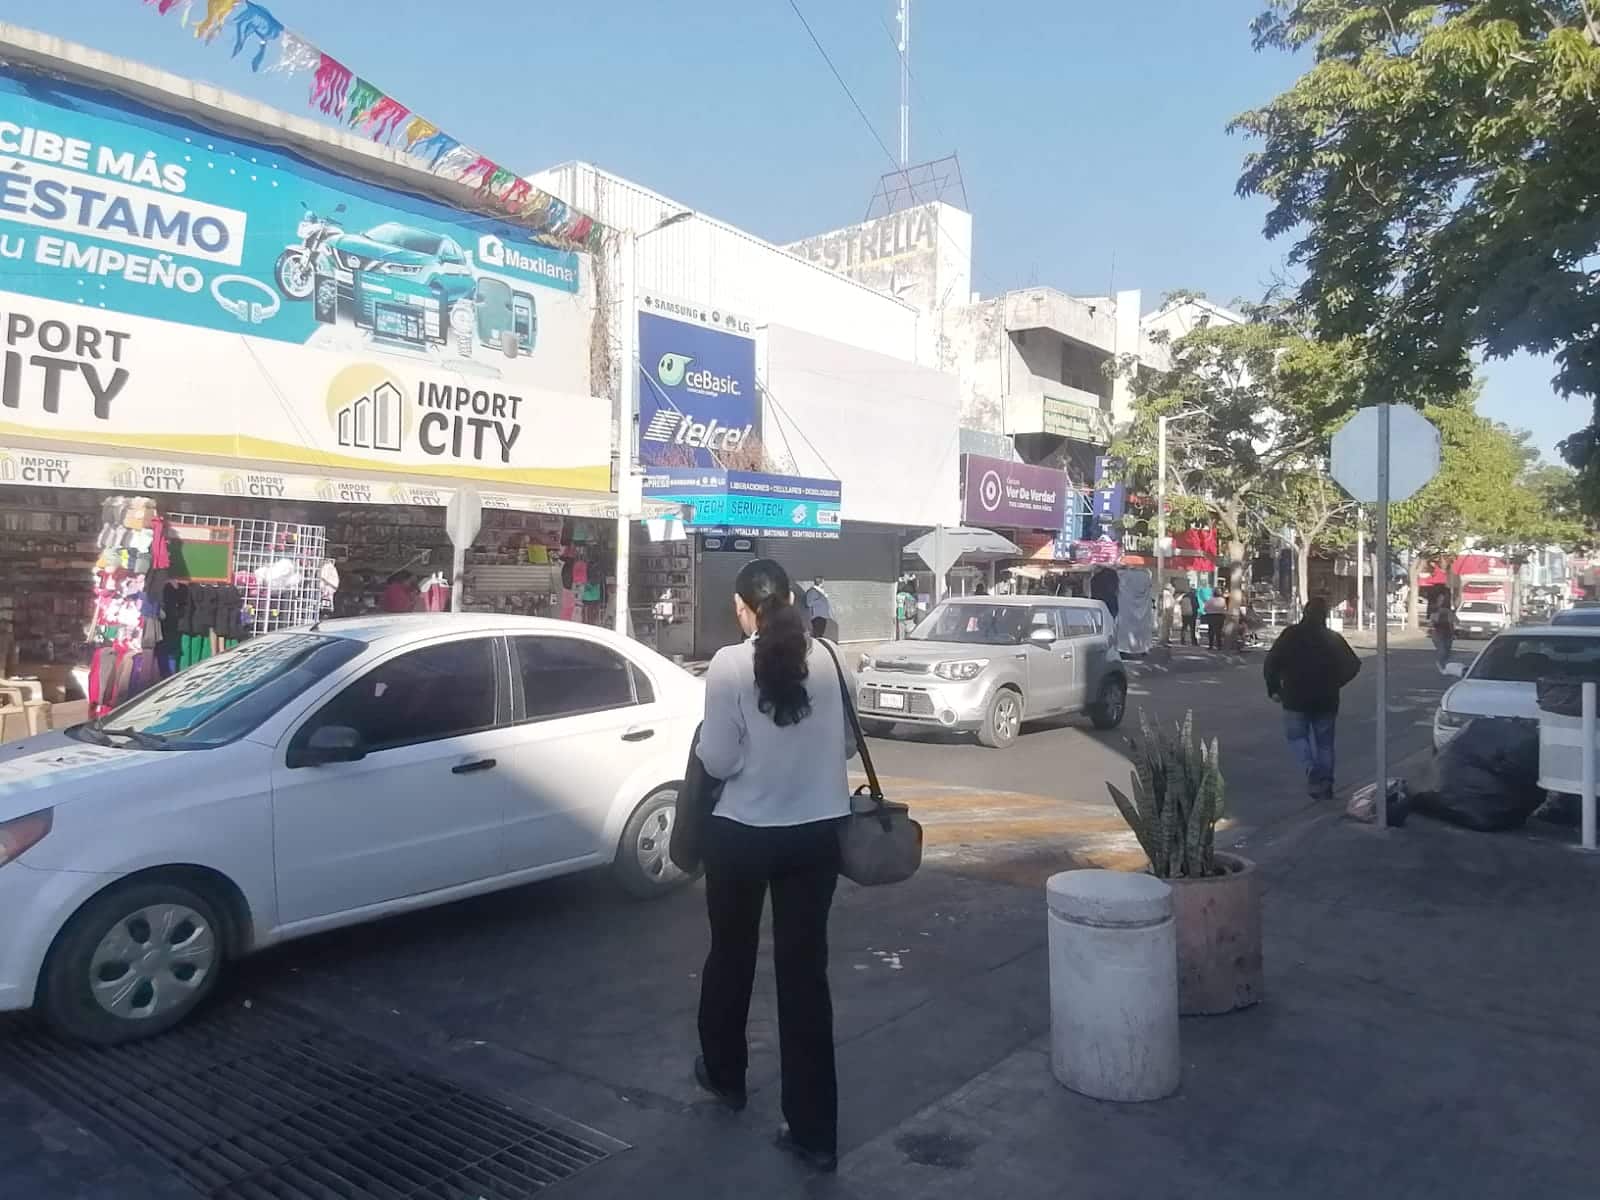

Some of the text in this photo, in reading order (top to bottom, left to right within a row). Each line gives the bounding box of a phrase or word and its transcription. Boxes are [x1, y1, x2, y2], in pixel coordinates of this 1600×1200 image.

[0, 121, 187, 193] CIBE MÁS
[35, 235, 204, 293] EMPEÑO
[505, 247, 573, 283] Maxilana
[654, 298, 698, 319] SAMSUNG
[738, 321, 750, 333] LG
[2, 350, 130, 420] ITY
[418, 381, 523, 420] IMPORT
[418, 411, 521, 463] CITY
[674, 415, 752, 451] telcel
[21, 456, 70, 469] IMPORT
[22, 467, 70, 483] CITY
[142, 466, 185, 477] IMPORT
[143, 476, 185, 490] CITY
[247, 475, 285, 485] IMPORT
[338, 483, 371, 491] IMPORT
[249, 484, 285, 496] CITY
[341, 491, 371, 502] CITY
[412, 496, 440, 505] CITY
